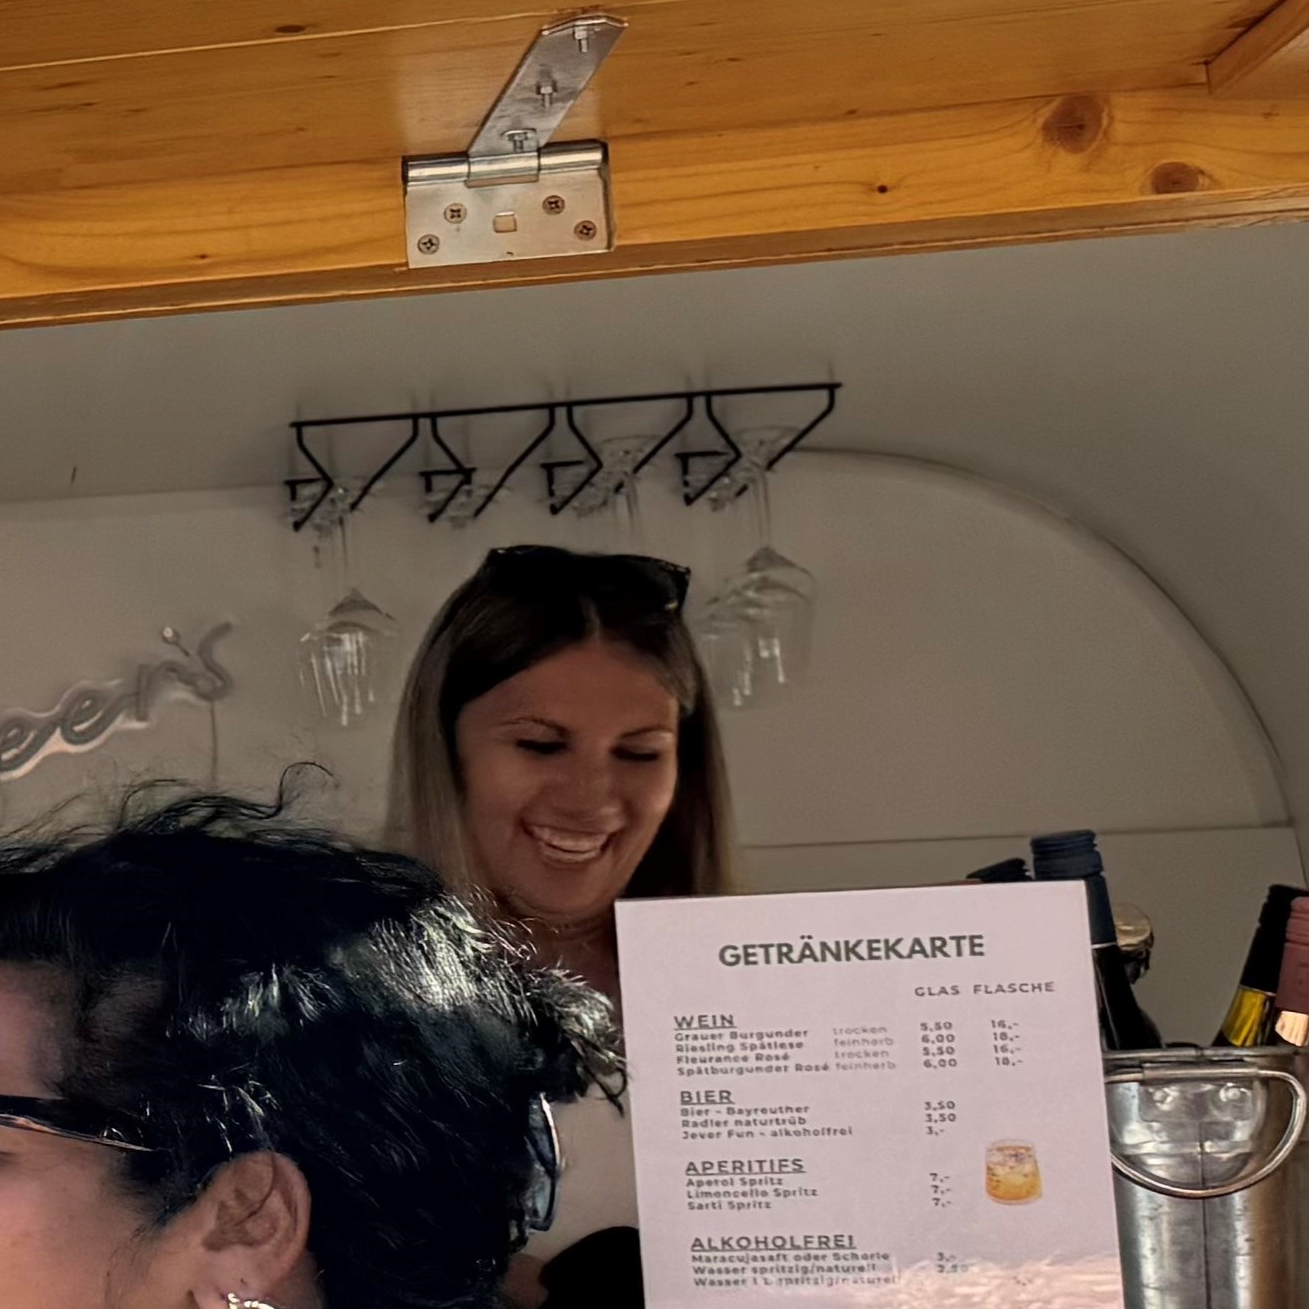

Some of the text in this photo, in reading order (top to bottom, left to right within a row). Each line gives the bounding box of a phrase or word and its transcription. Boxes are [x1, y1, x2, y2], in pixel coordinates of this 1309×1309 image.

[718, 934, 985, 967] GETRÄNKEKARTE
[914, 981, 1055, 997] GLAS FLASCHE
[673, 1014, 736, 1029] WEIN
[674, 1032, 724, 1042] Grauer
[729, 1029, 809, 1041] Burgunder
[832, 1025, 888, 1036] trocken
[675, 1043, 736, 1054] Riesling
[739, 1040, 805, 1052] Spätlese
[833, 1036, 894, 1048] feinherb
[676, 1054, 750, 1065] Fleurance
[754, 1052, 790, 1062] Rosé
[833, 1049, 890, 1060] trocken
[677, 1064, 790, 1077] Spätburgunder
[794, 1062, 831, 1072] Rosé
[834, 1060, 897, 1072] feinherb
[680, 1090, 733, 1104] BIER
[680, 1106, 711, 1117] Bier
[726, 1104, 810, 1117] Bayreuther
[681, 1118, 730, 1128] Radler
[733, 1115, 807, 1127] naturtrüb
[681, 1129, 723, 1140] Jever
[727, 1129, 755, 1139] Fun
[770, 1126, 854, 1137] alkoholfrei
[685, 1158, 805, 1175] APERITIFS
[686, 1177, 734, 1189] Aperol
[739, 1176, 784, 1188] Spritz
[687, 1188, 770, 1199] Limoncello
[773, 1187, 819, 1199] Spritz
[687, 1200, 723, 1211] Sarti
[727, 1199, 772, 1211] Spritz
[690, 1234, 856, 1252] ALKOHOLFREI
[691, 1253, 788, 1264] Maracujasaft
[792, 1252, 828, 1262] oder
[832, 1252, 891, 1262] Schorle
[692, 1265, 746, 1275] Wasser
[693, 1277, 747, 1287] Wasser
